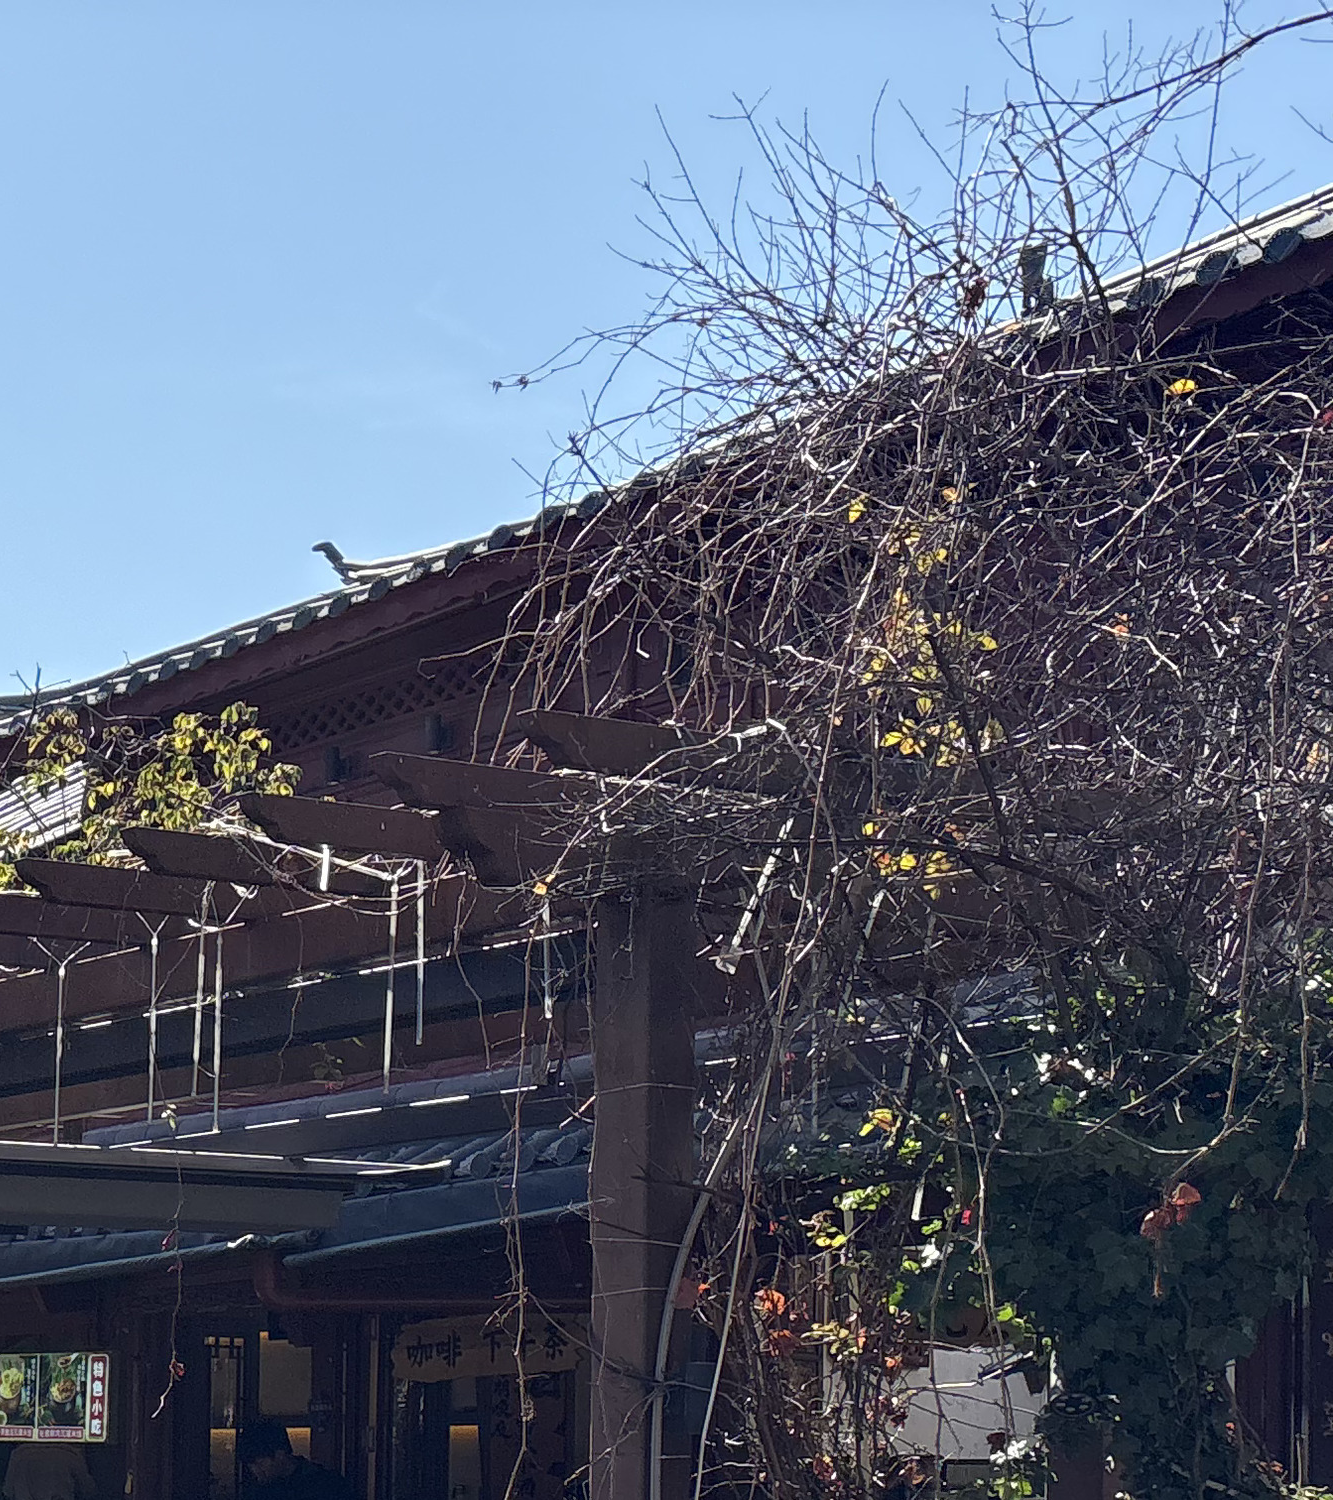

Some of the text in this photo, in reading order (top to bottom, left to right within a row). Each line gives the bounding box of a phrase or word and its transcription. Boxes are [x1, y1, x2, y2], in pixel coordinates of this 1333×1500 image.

[406, 1329, 462, 1368] 咖啡
[90, 1360, 105, 1435] 特色小吃
